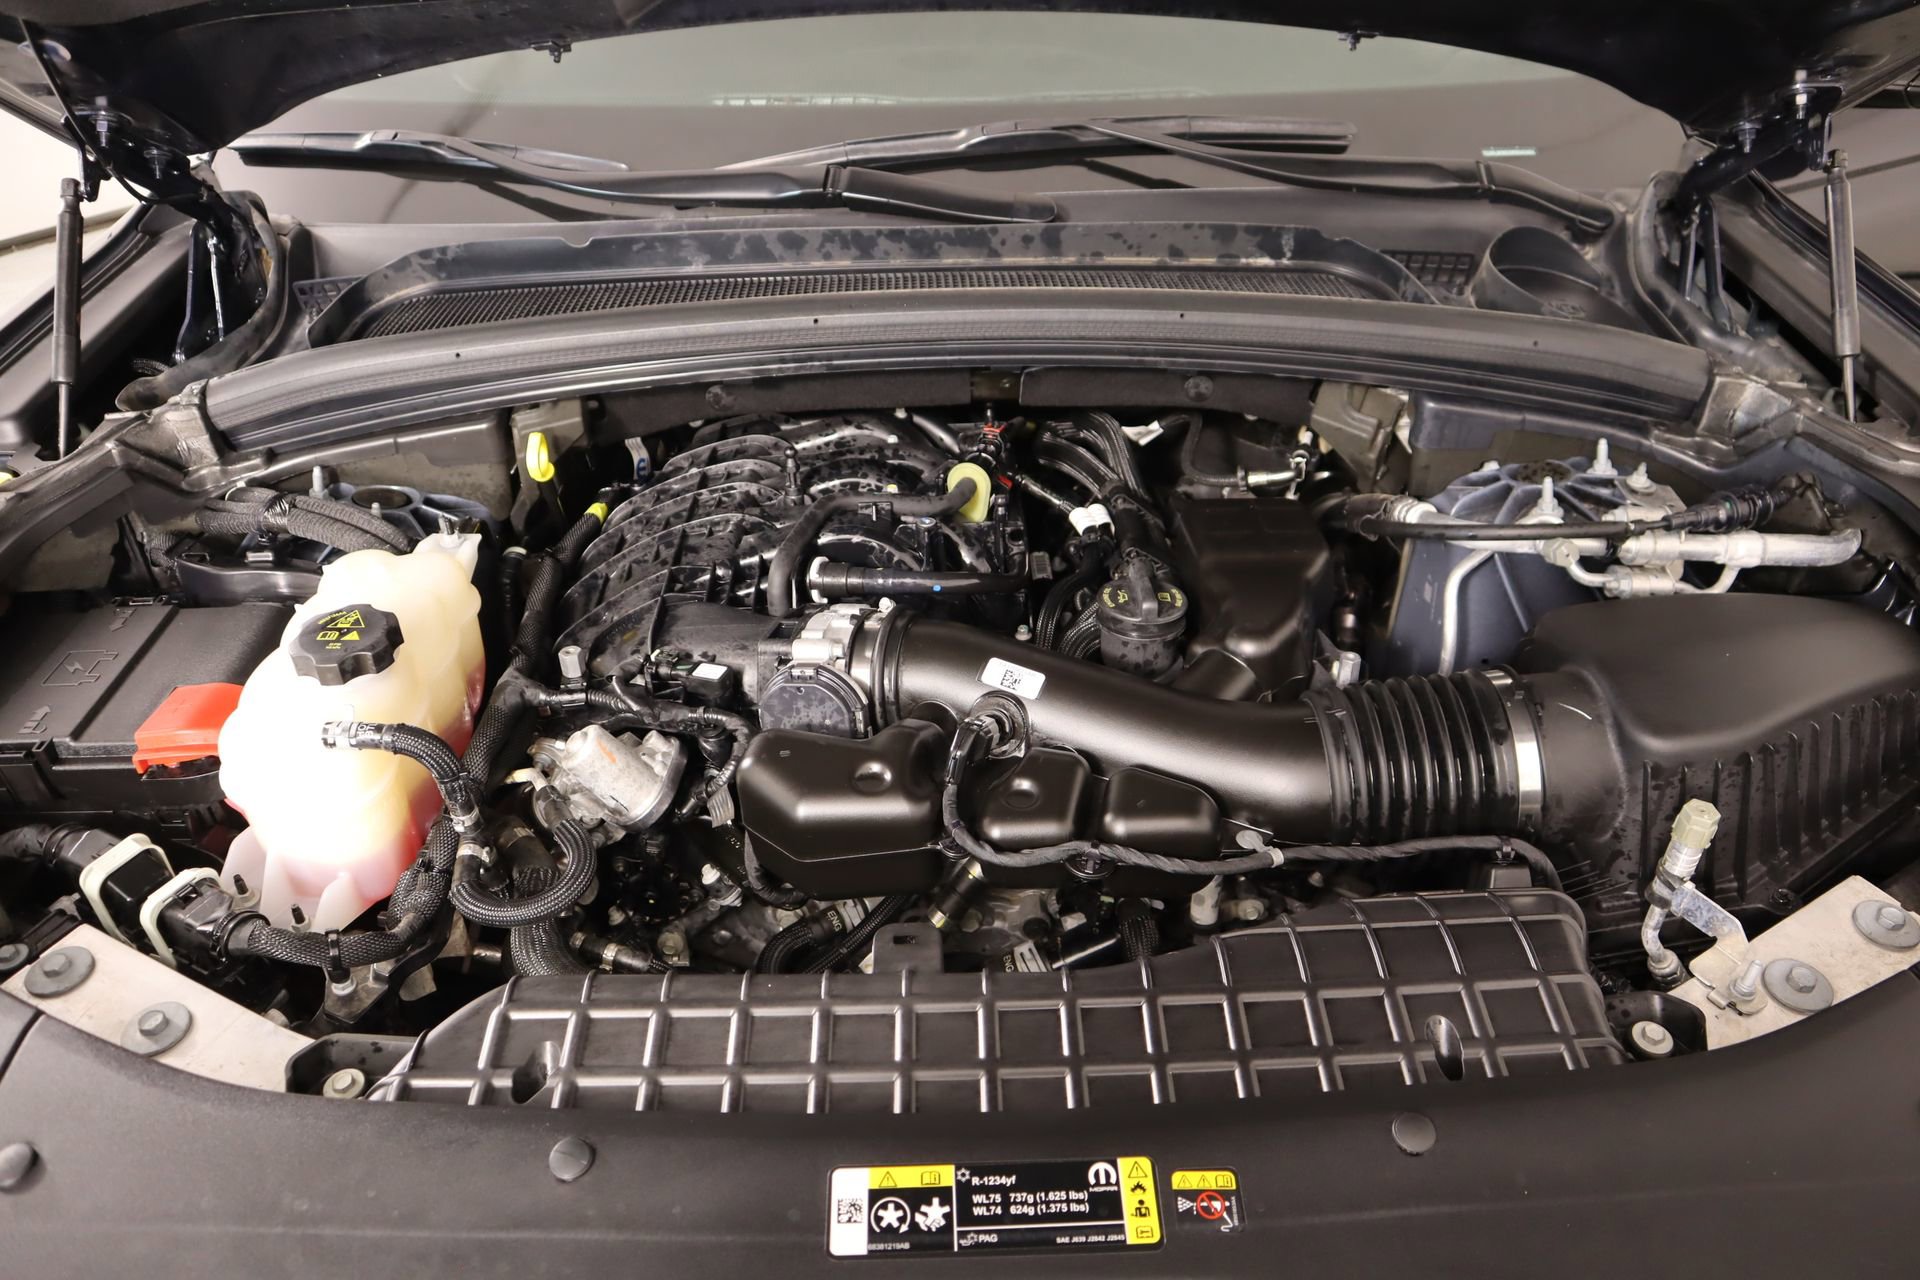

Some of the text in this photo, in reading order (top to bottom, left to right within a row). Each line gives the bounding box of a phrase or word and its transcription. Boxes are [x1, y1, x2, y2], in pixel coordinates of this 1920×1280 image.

[827, 910, 842, 932] ENG
[971, 1174, 1016, 1187] R-1234yf
[972, 1190, 1088, 1204] WL75 737g (1.625 lbs)
[972, 1202, 1089, 1216] WL74 624g (1.375 lbs)
[978, 1233, 998, 1243] PAG
[1056, 1236, 1070, 1244] SAE
